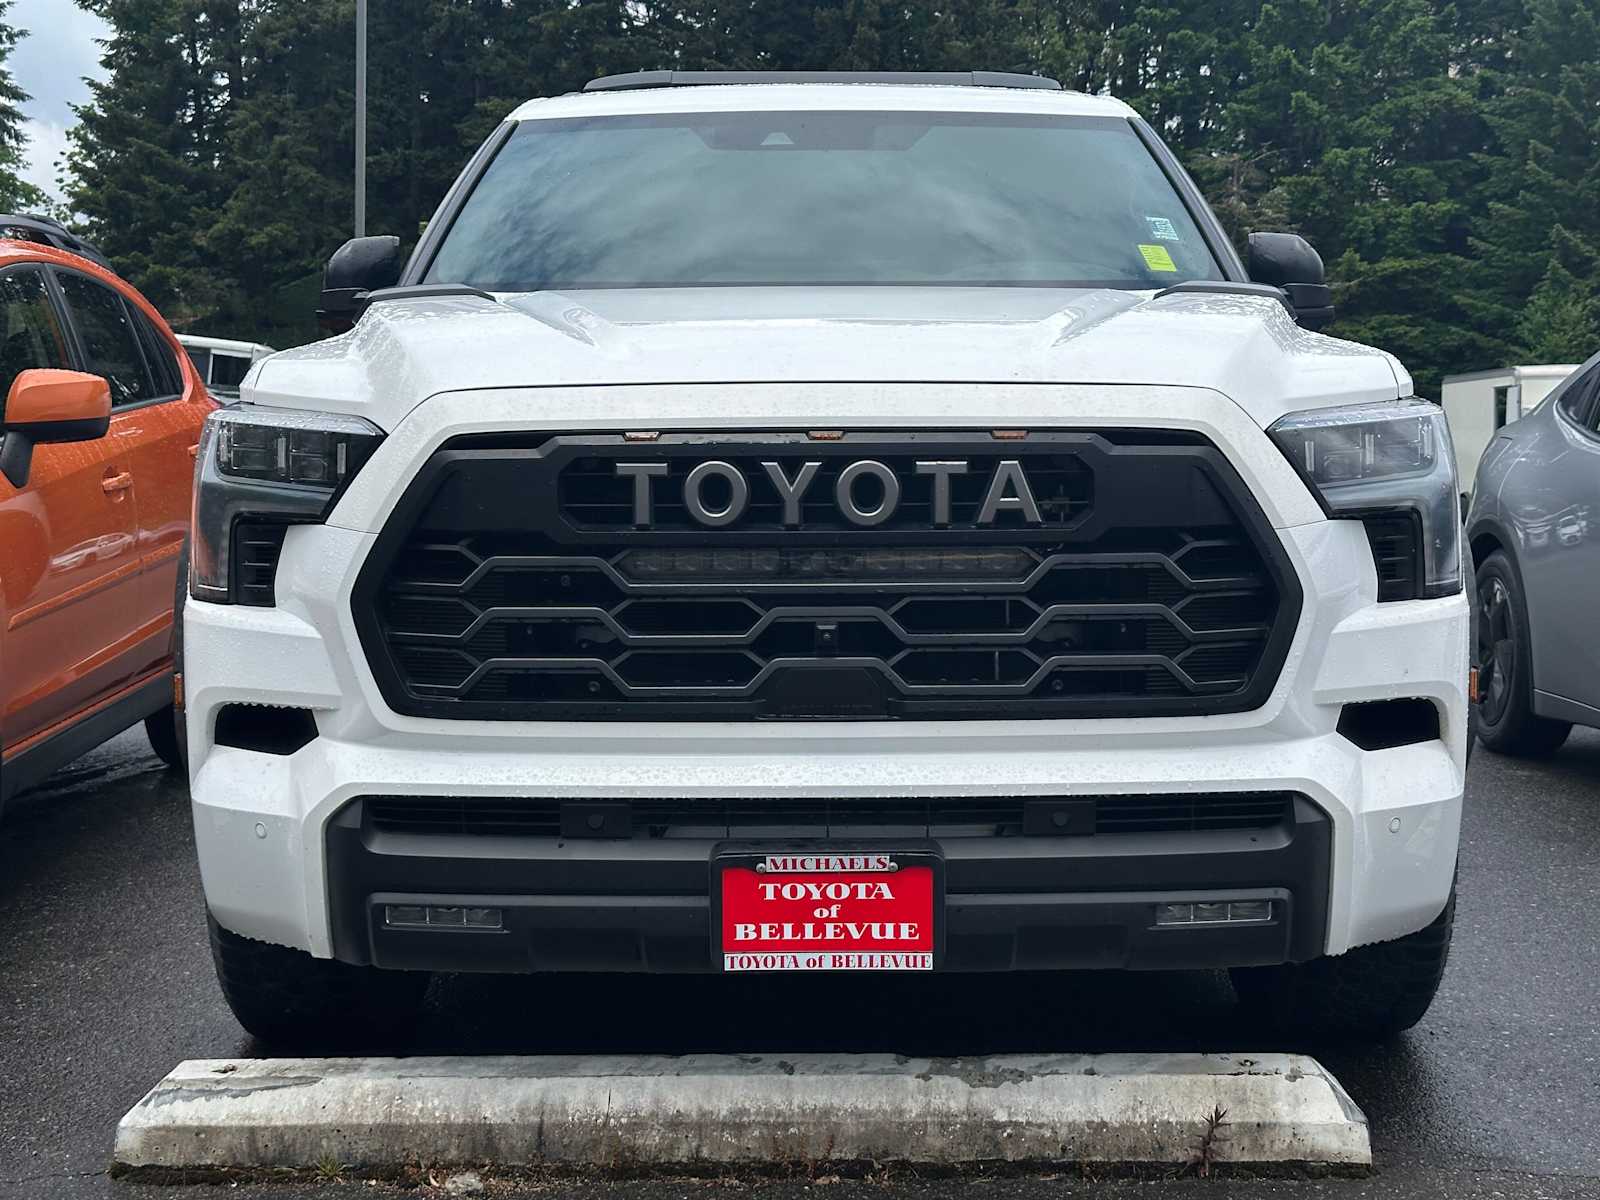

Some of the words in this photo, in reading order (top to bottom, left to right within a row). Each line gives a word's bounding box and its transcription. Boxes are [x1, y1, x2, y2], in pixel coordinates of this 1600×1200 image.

[615, 460, 1043, 527] TOYOTA
[768, 856, 888, 871] MICHAELS
[758, 883, 895, 900] TOYOTA
[813, 904, 842, 918] of
[734, 923, 920, 940] BELLEVUE
[726, 955, 799, 969] TOYOTA
[806, 954, 826, 969] of
[832, 954, 932, 969] BELLEVUE
